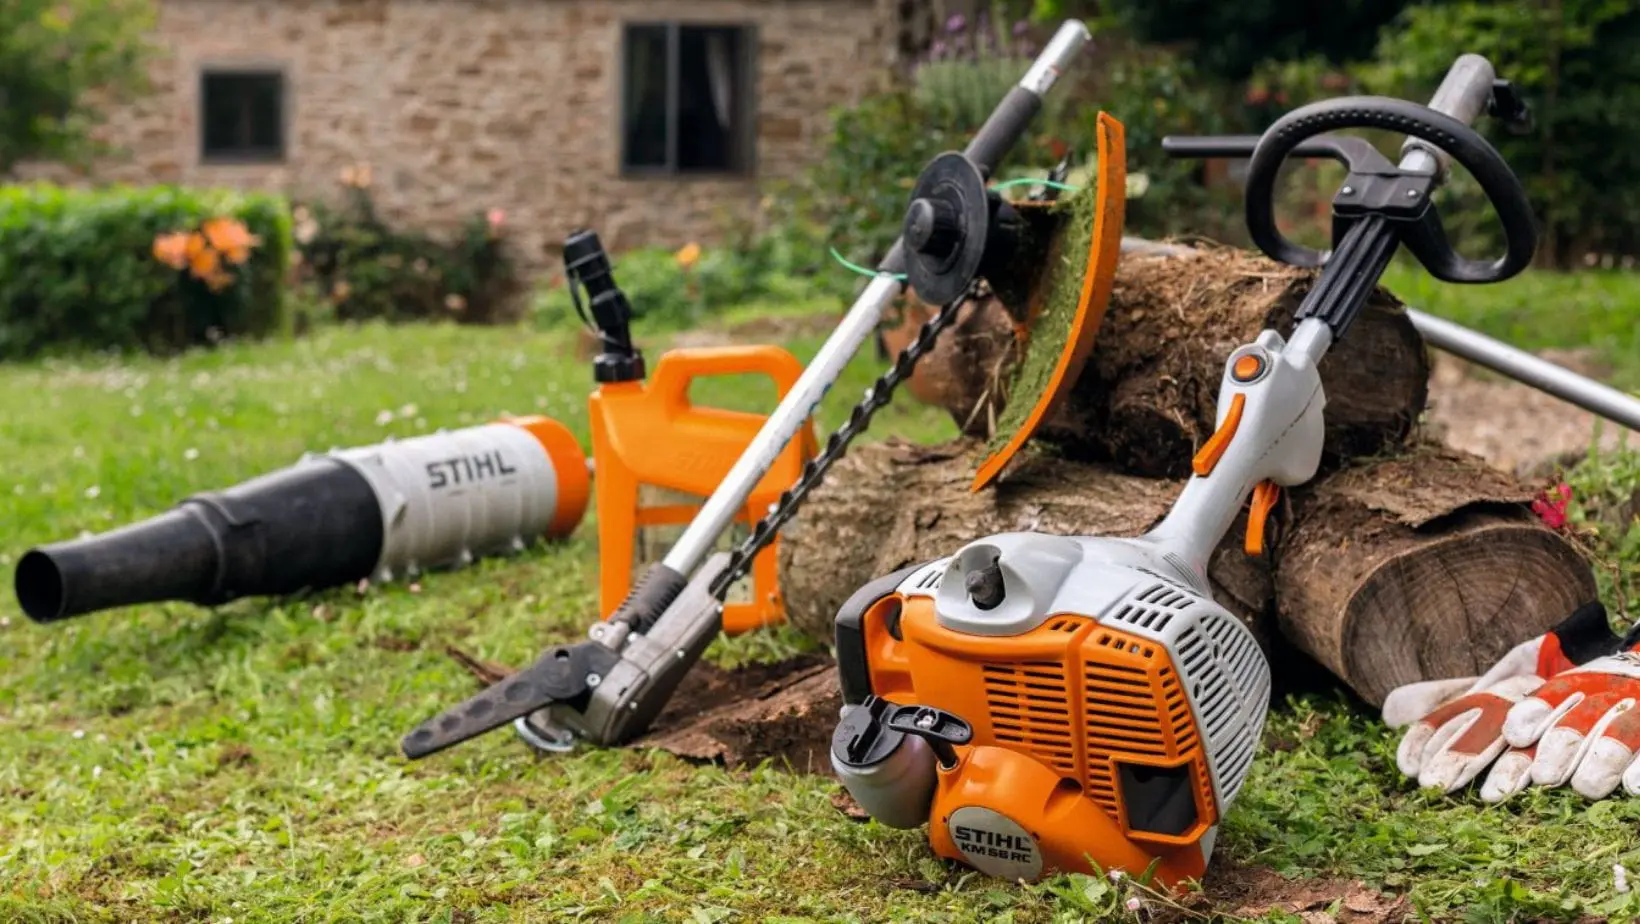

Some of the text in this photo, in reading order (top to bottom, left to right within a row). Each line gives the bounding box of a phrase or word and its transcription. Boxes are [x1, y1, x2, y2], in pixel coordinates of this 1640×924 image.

[426, 449, 516, 489] STIHL
[955, 825, 1032, 853] STIHL
[961, 842, 986, 856] KM
[1011, 852, 1032, 864] RC
